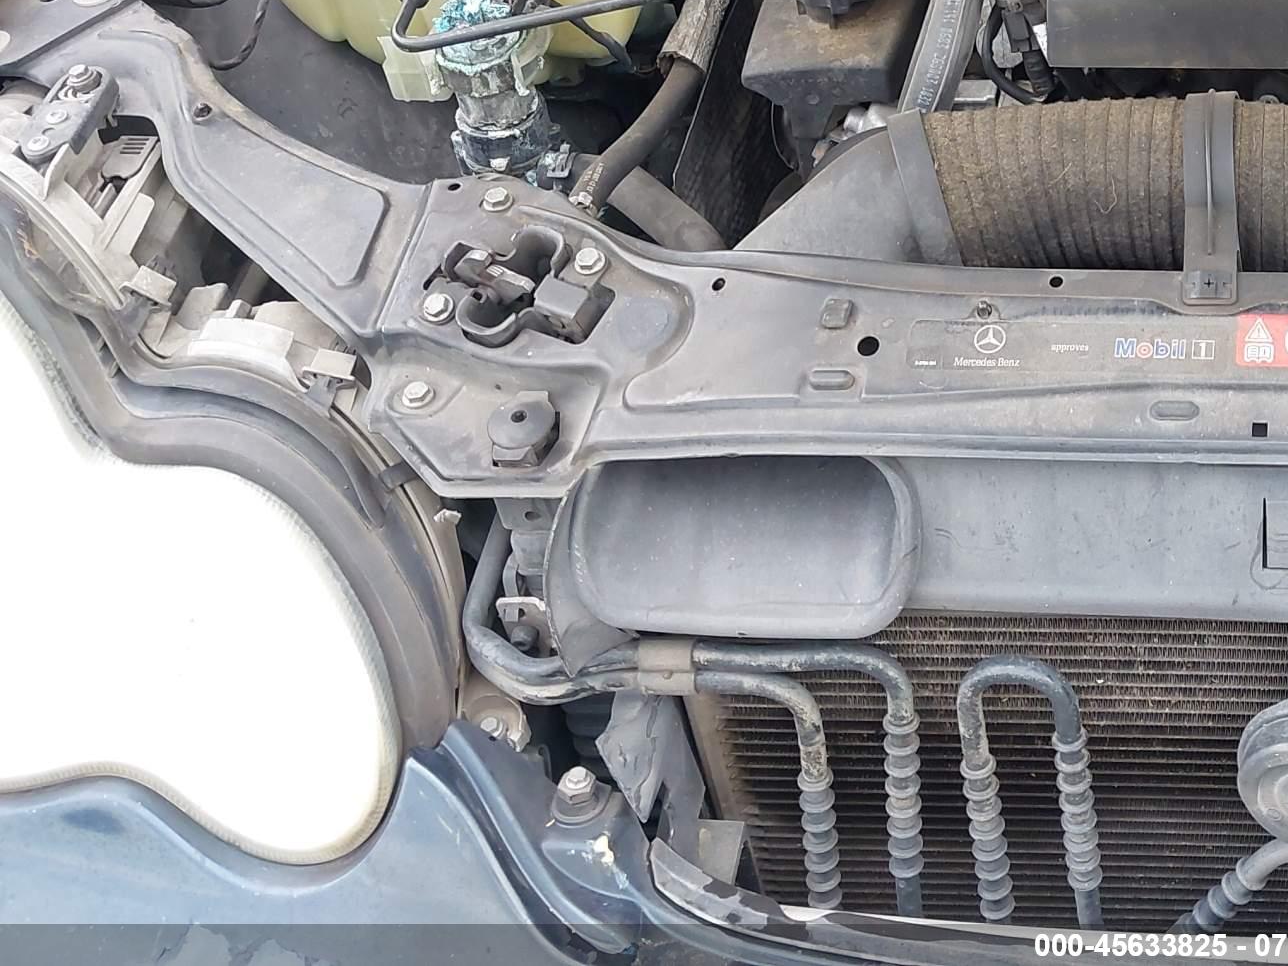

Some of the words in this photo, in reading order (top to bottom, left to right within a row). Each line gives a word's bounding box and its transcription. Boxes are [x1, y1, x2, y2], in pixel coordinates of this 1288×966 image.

[1051, 342, 1089, 353] approves
[1114, 337, 1187, 359] Mobil
[953, 356, 996, 367] Mercedes
[998, 357, 1020, 367] Benz
